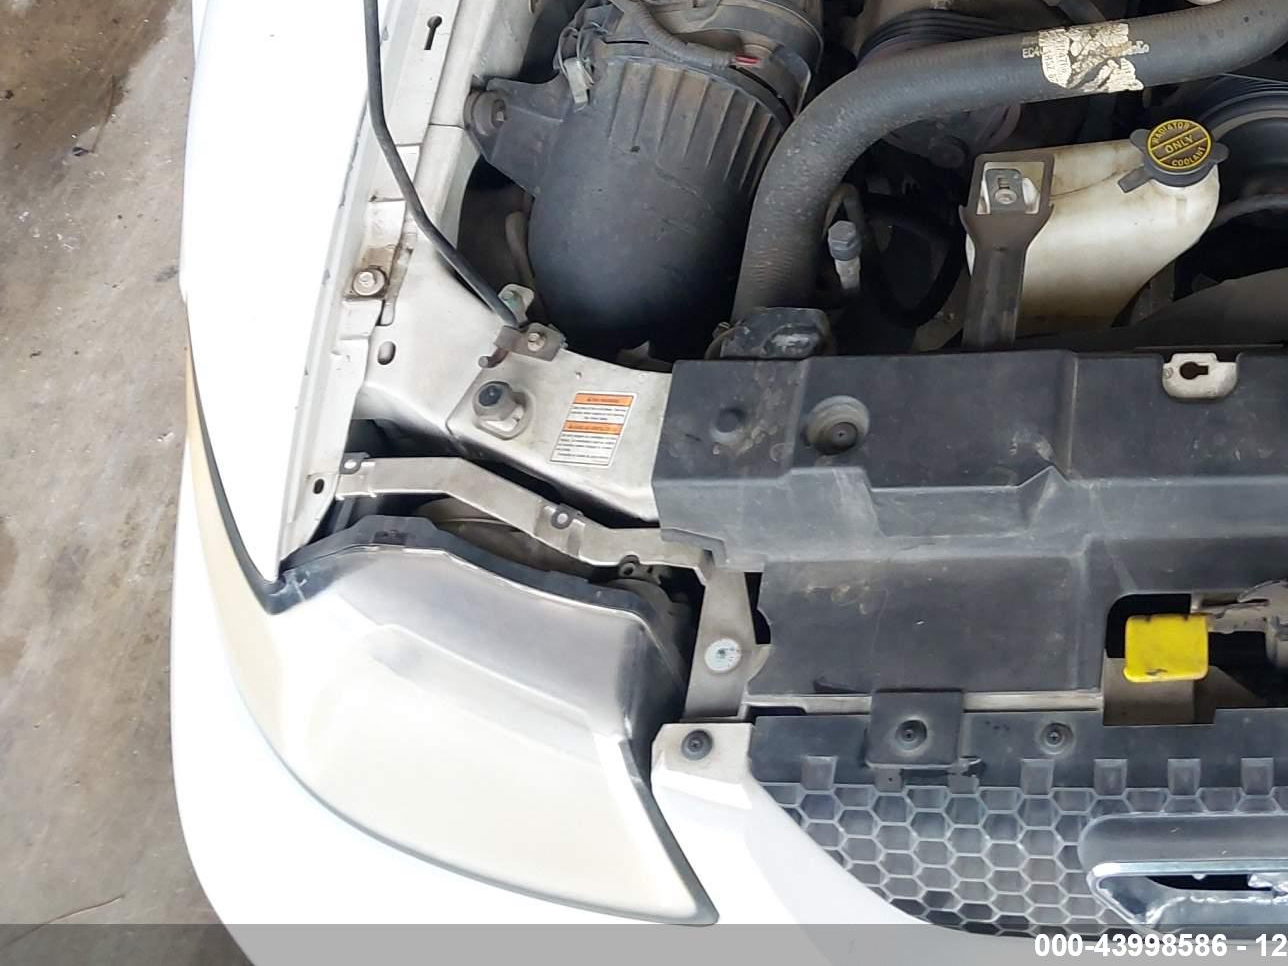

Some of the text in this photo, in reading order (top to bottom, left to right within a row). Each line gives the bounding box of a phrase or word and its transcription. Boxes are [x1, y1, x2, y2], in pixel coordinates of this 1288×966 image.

[1151, 121, 1191, 144] RADIATOR
[1164, 134, 1194, 154] ONLY
[1171, 146, 1206, 167] COOLANT
